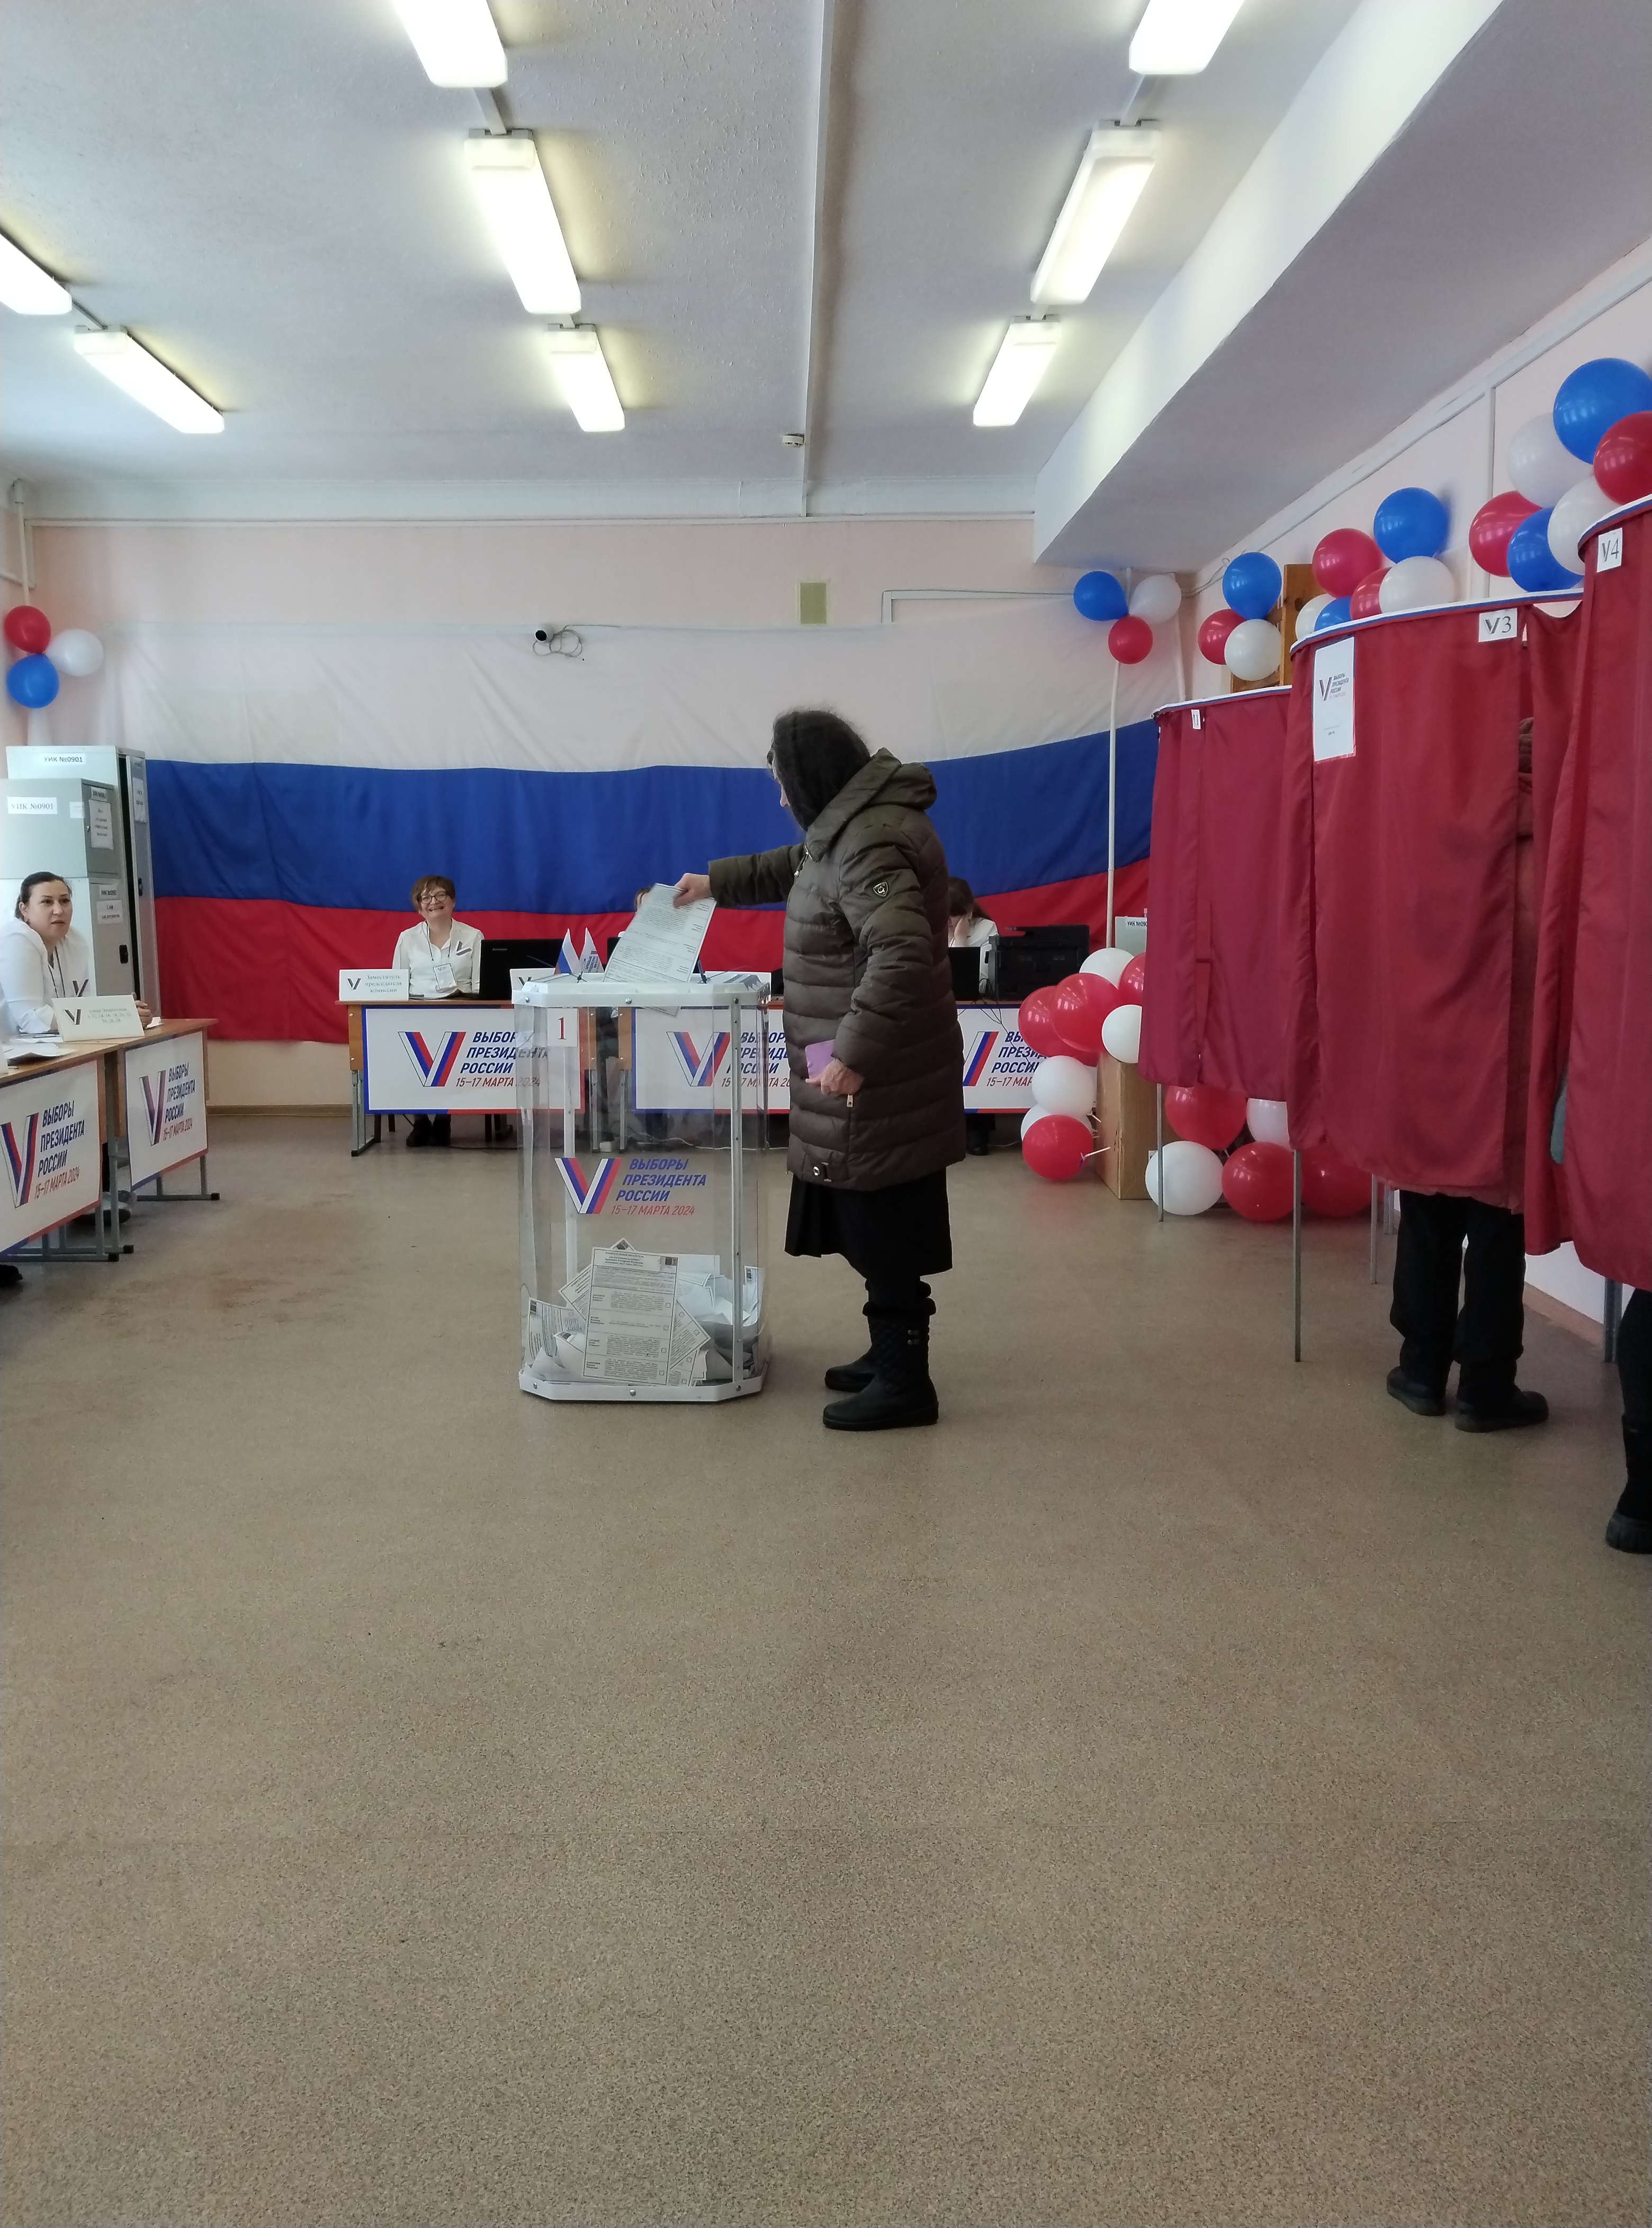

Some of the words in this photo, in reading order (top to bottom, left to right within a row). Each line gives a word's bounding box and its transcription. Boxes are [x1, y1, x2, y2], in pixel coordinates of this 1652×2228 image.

[472, 1031, 516, 1043] ВЫБОР
[558, 1017, 567, 1040] 1
[168, 1062, 190, 1082] ВЫБОРЫ
[460, 1062, 514, 1074] РОССИИ
[482, 1077, 514, 1087] МАРТА
[1012, 1076, 1032, 1086] МАР
[167, 1079, 195, 1103] ПРЕЗИДЕНТА
[42, 1100, 75, 1128] ВЫБОРЫ
[165, 1102, 184, 1123] РОССИИ
[40, 1119, 85, 1153] ПРЕЗИДЕНТА
[38, 1149, 68, 1178] РОССИИ
[629, 1158, 689, 1170] ВЫБОРЫ
[50, 1171, 68, 1193] МАРТА
[67, 1166, 80, 1184] 2024
[622, 1174, 707, 1188] ПРЕЗИДЕНТА
[615, 1190, 671, 1202] РОССИИ
[638, 1205, 670, 1215] МАРТА
[671, 1205, 695, 1216] 2024
